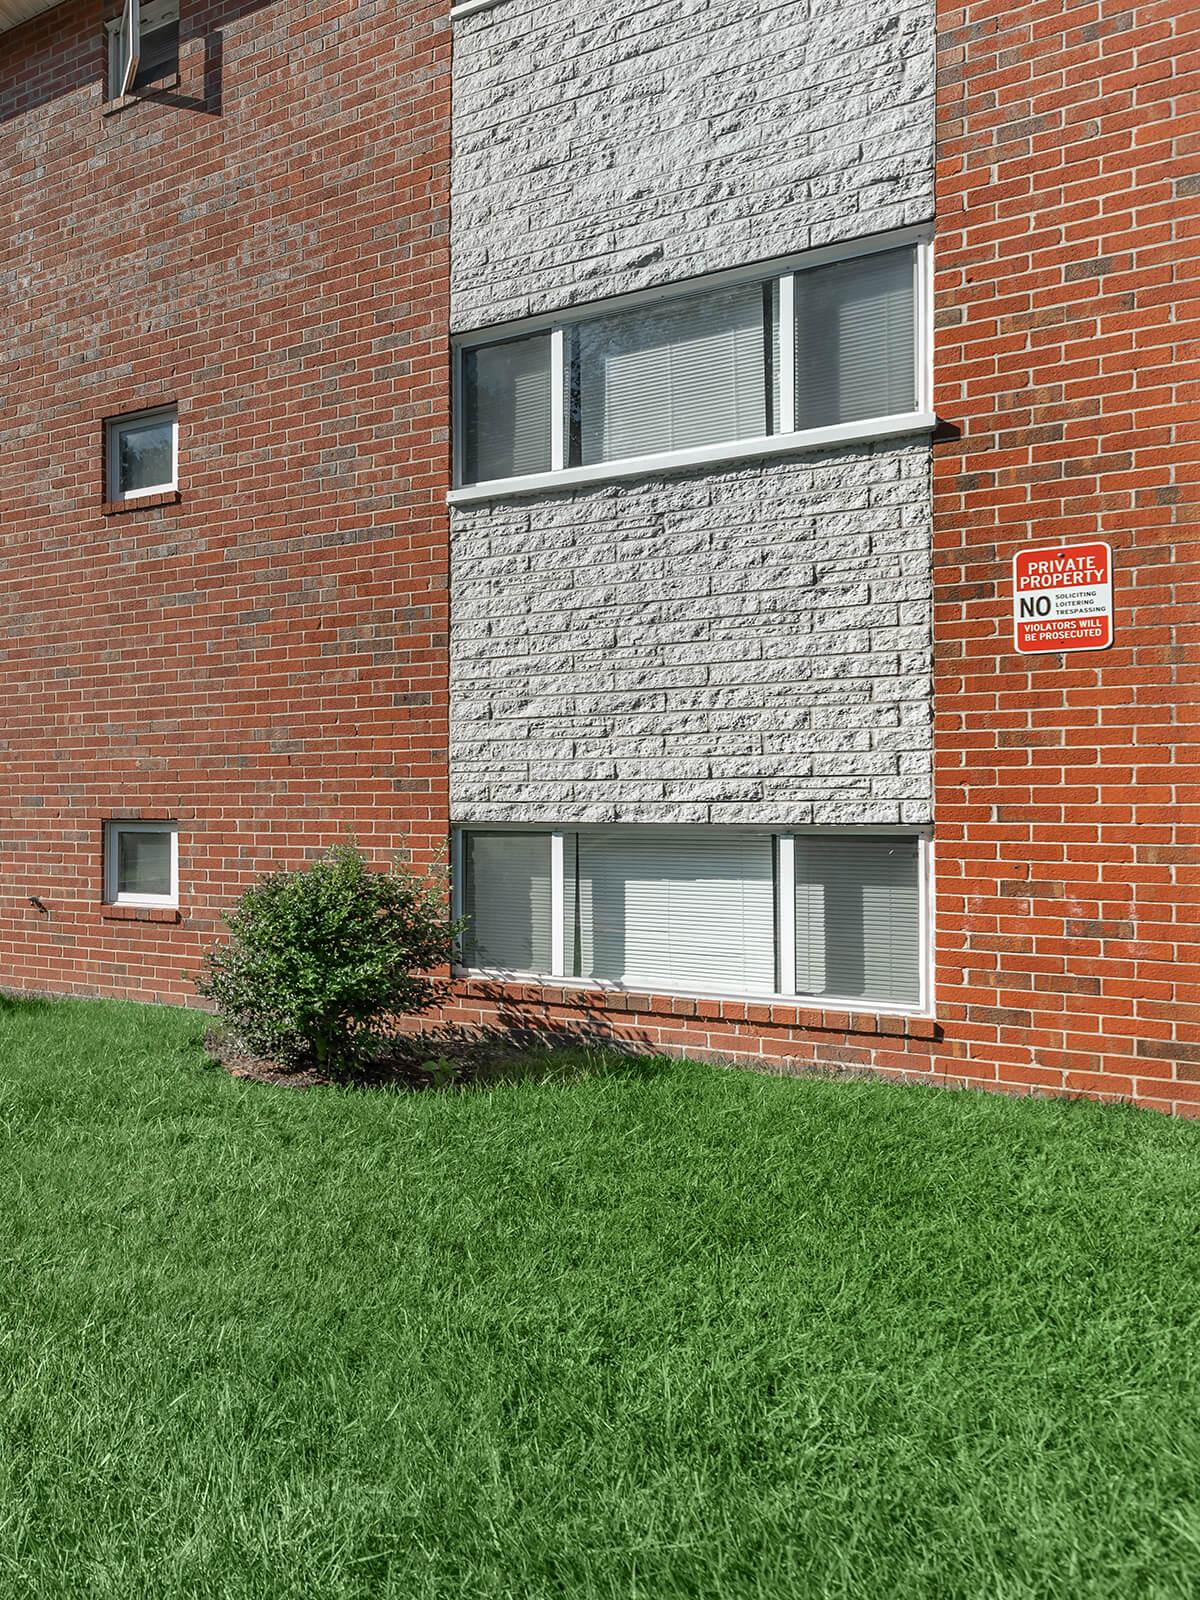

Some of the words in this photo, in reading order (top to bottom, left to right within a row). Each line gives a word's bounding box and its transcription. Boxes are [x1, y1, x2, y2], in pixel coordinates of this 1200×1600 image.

[1028, 556, 1096, 575] PRIVATE
[1020, 569, 1104, 589] PROPERTY
[1056, 591, 1097, 600] SOLICITING
[1020, 596, 1051, 618] NO
[1056, 599, 1094, 608] LOITERING
[1056, 606, 1106, 615] TRESPASSING
[1024, 621, 1077, 632] VIOLATORS
[1078, 619, 1102, 628] WILL
[1024, 633, 1038, 642] BE
[1040, 628, 1102, 640] PROSECUTED
